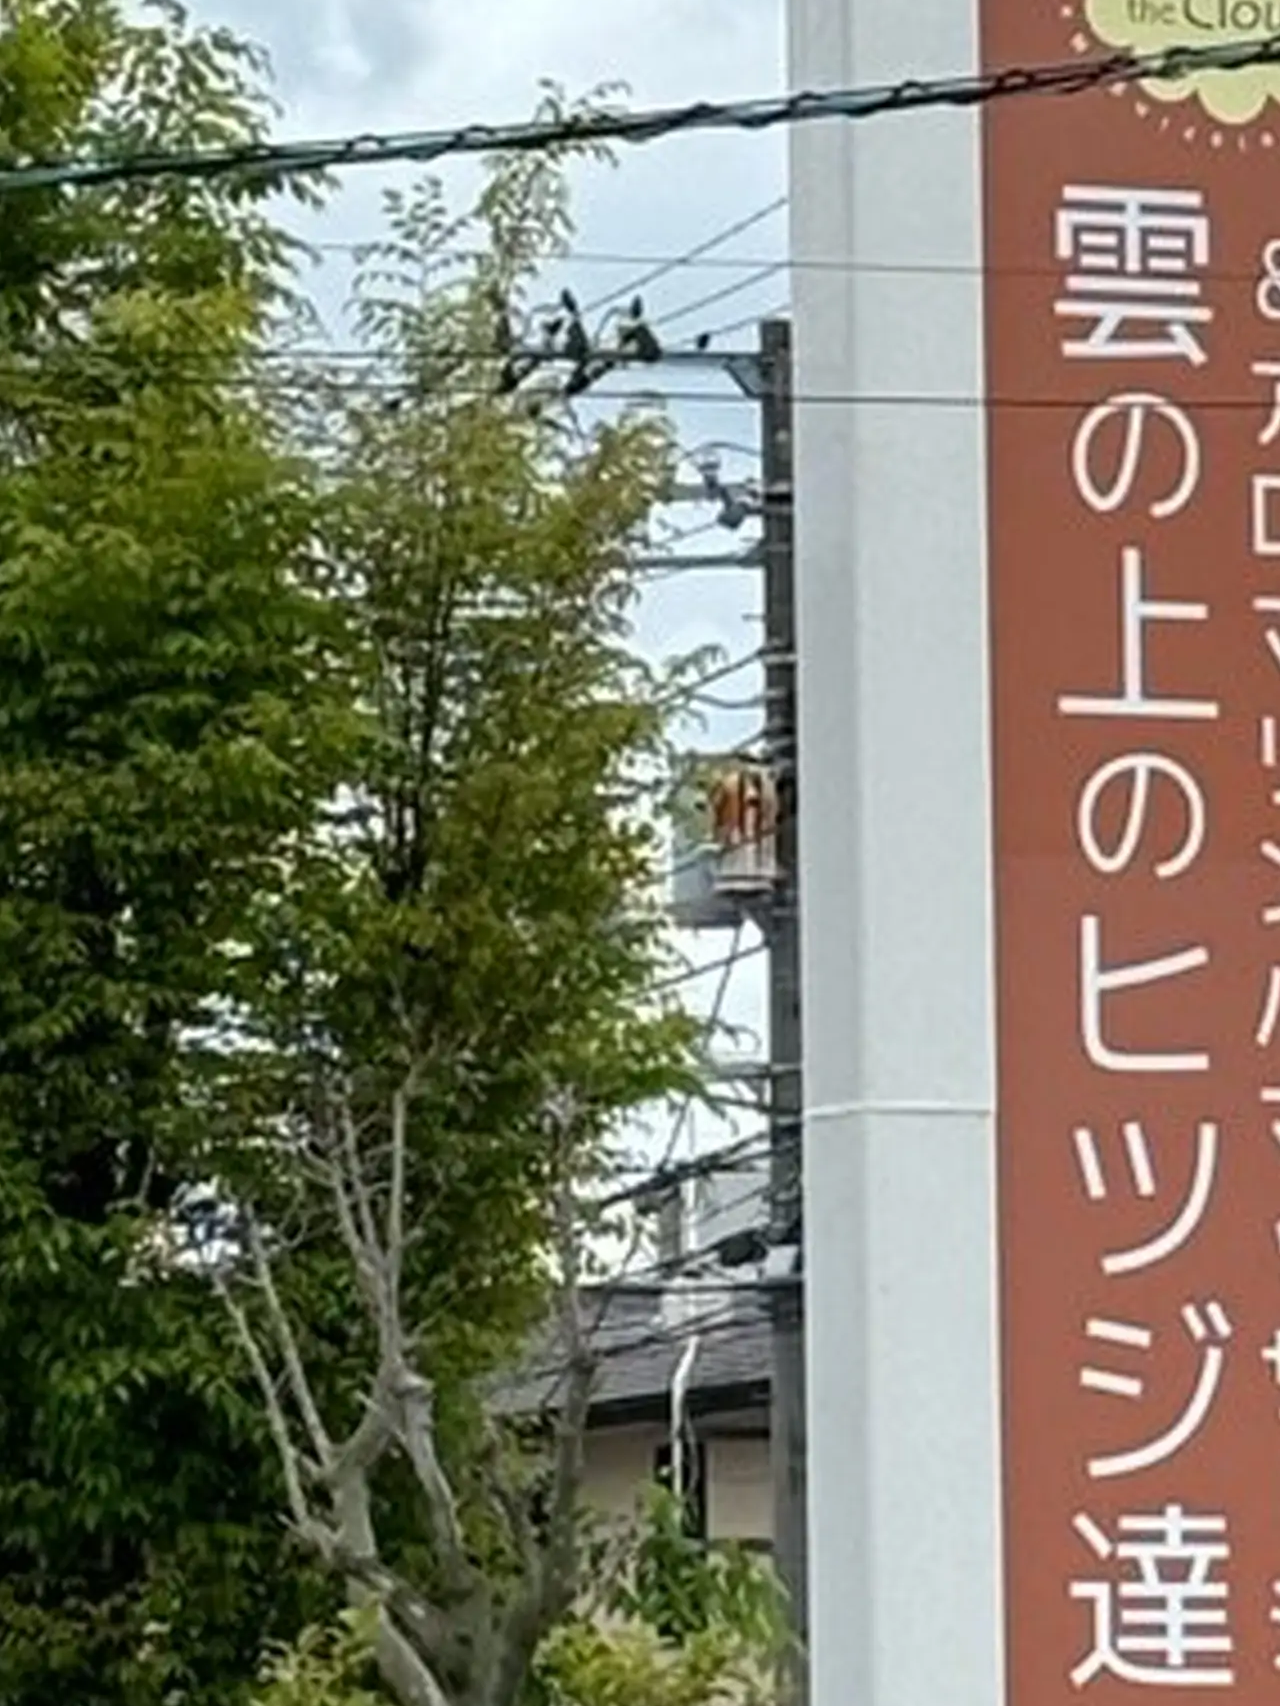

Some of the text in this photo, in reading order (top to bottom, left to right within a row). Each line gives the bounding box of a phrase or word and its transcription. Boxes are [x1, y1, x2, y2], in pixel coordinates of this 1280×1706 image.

[1053, 184, 1235, 1687] 雲の上のヒツジ達
